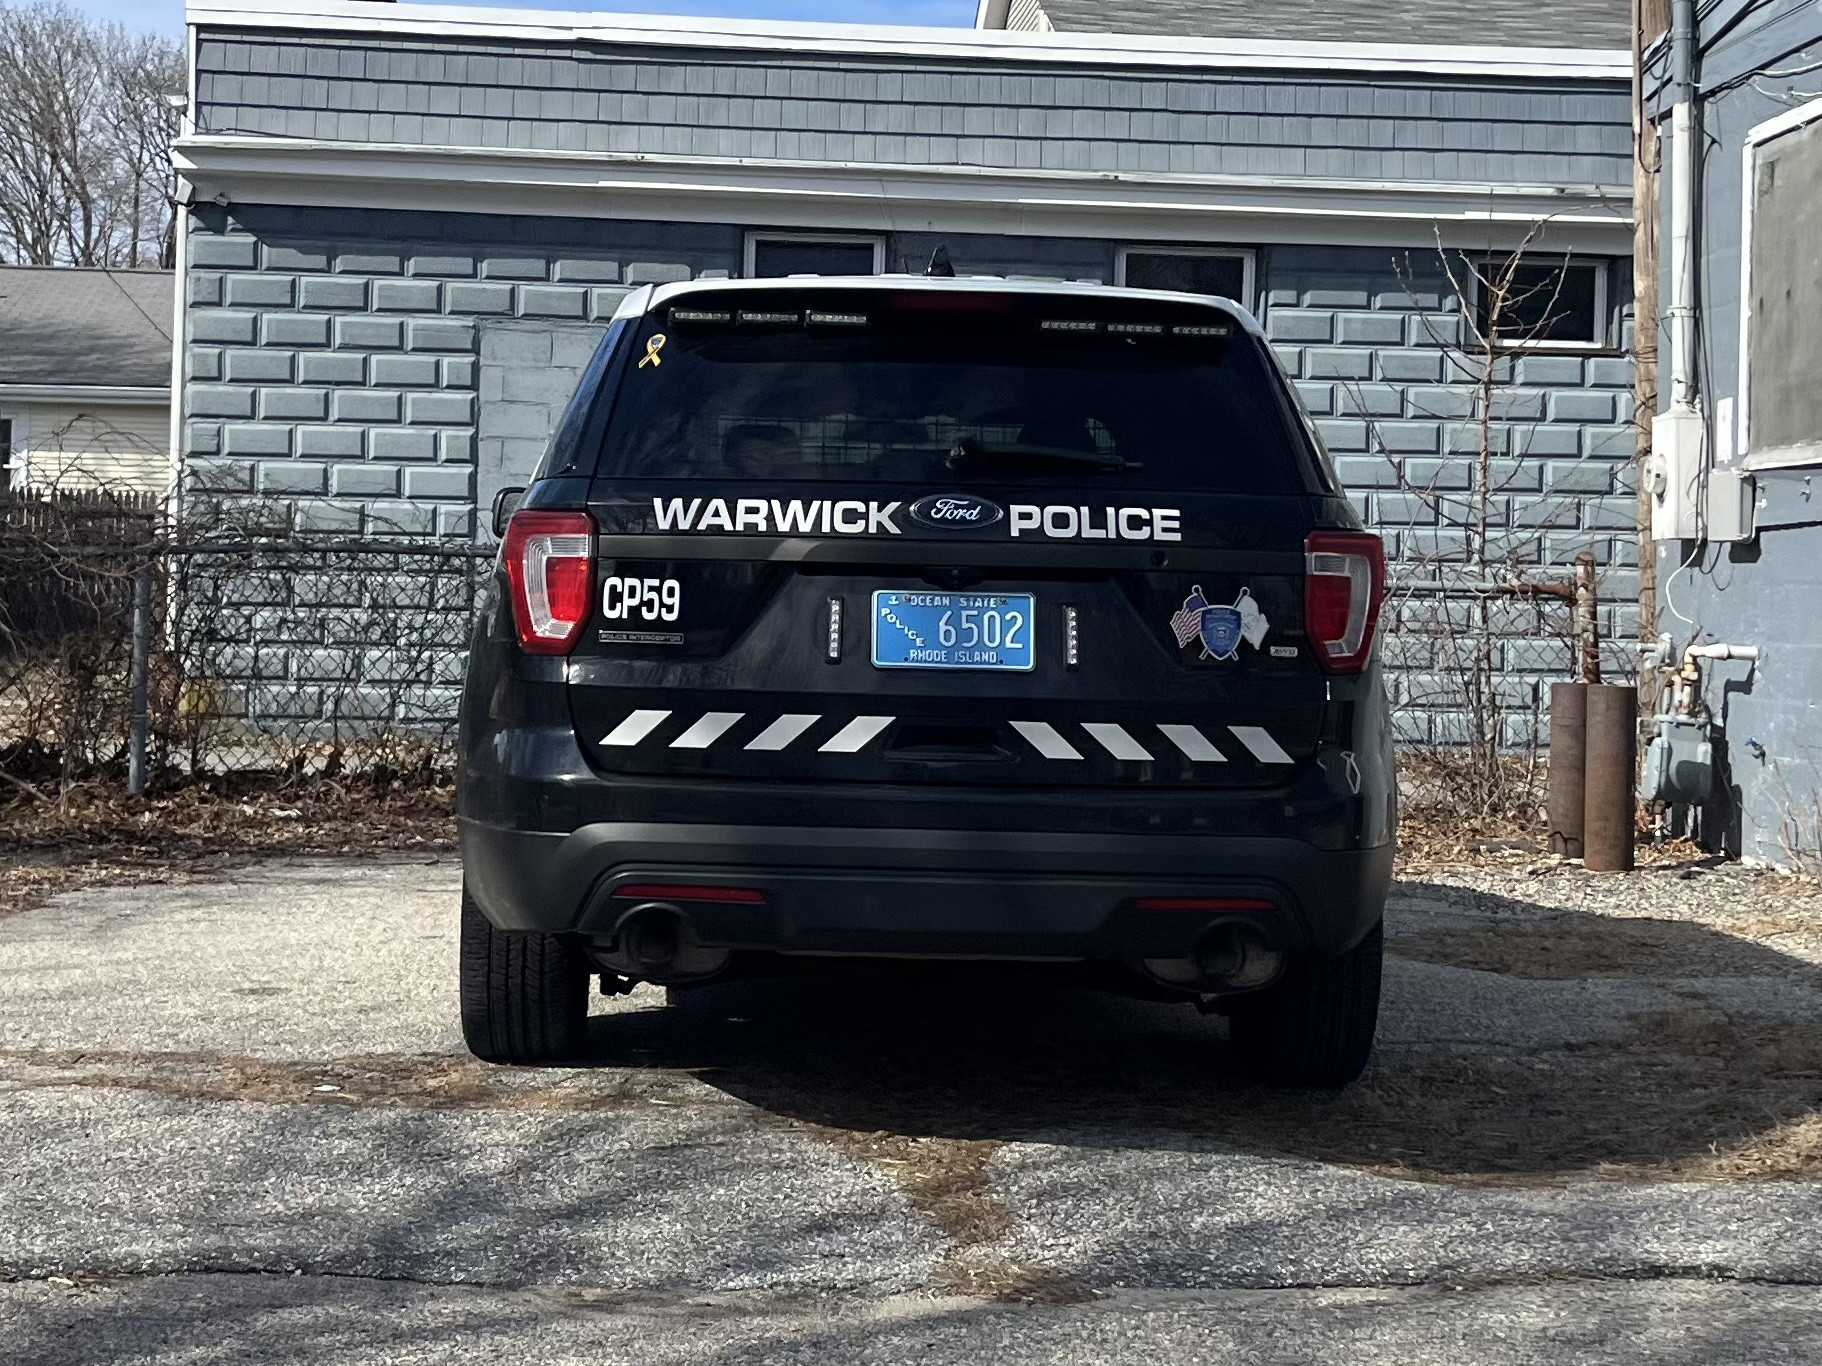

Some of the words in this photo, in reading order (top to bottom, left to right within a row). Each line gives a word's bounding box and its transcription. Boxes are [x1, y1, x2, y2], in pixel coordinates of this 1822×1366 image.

[653, 497, 902, 534] WARWICK
[1009, 504, 1182, 541] POLICE
[930, 498, 982, 520] Ford
[602, 576, 680, 621] CP59
[909, 594, 950, 607] OCEAN
[958, 596, 998, 608] STATE
[880, 607, 926, 647] POLICE
[938, 610, 1024, 649] 6502
[909, 649, 949, 663] RHODE
[954, 650, 998, 664] ISLAND
